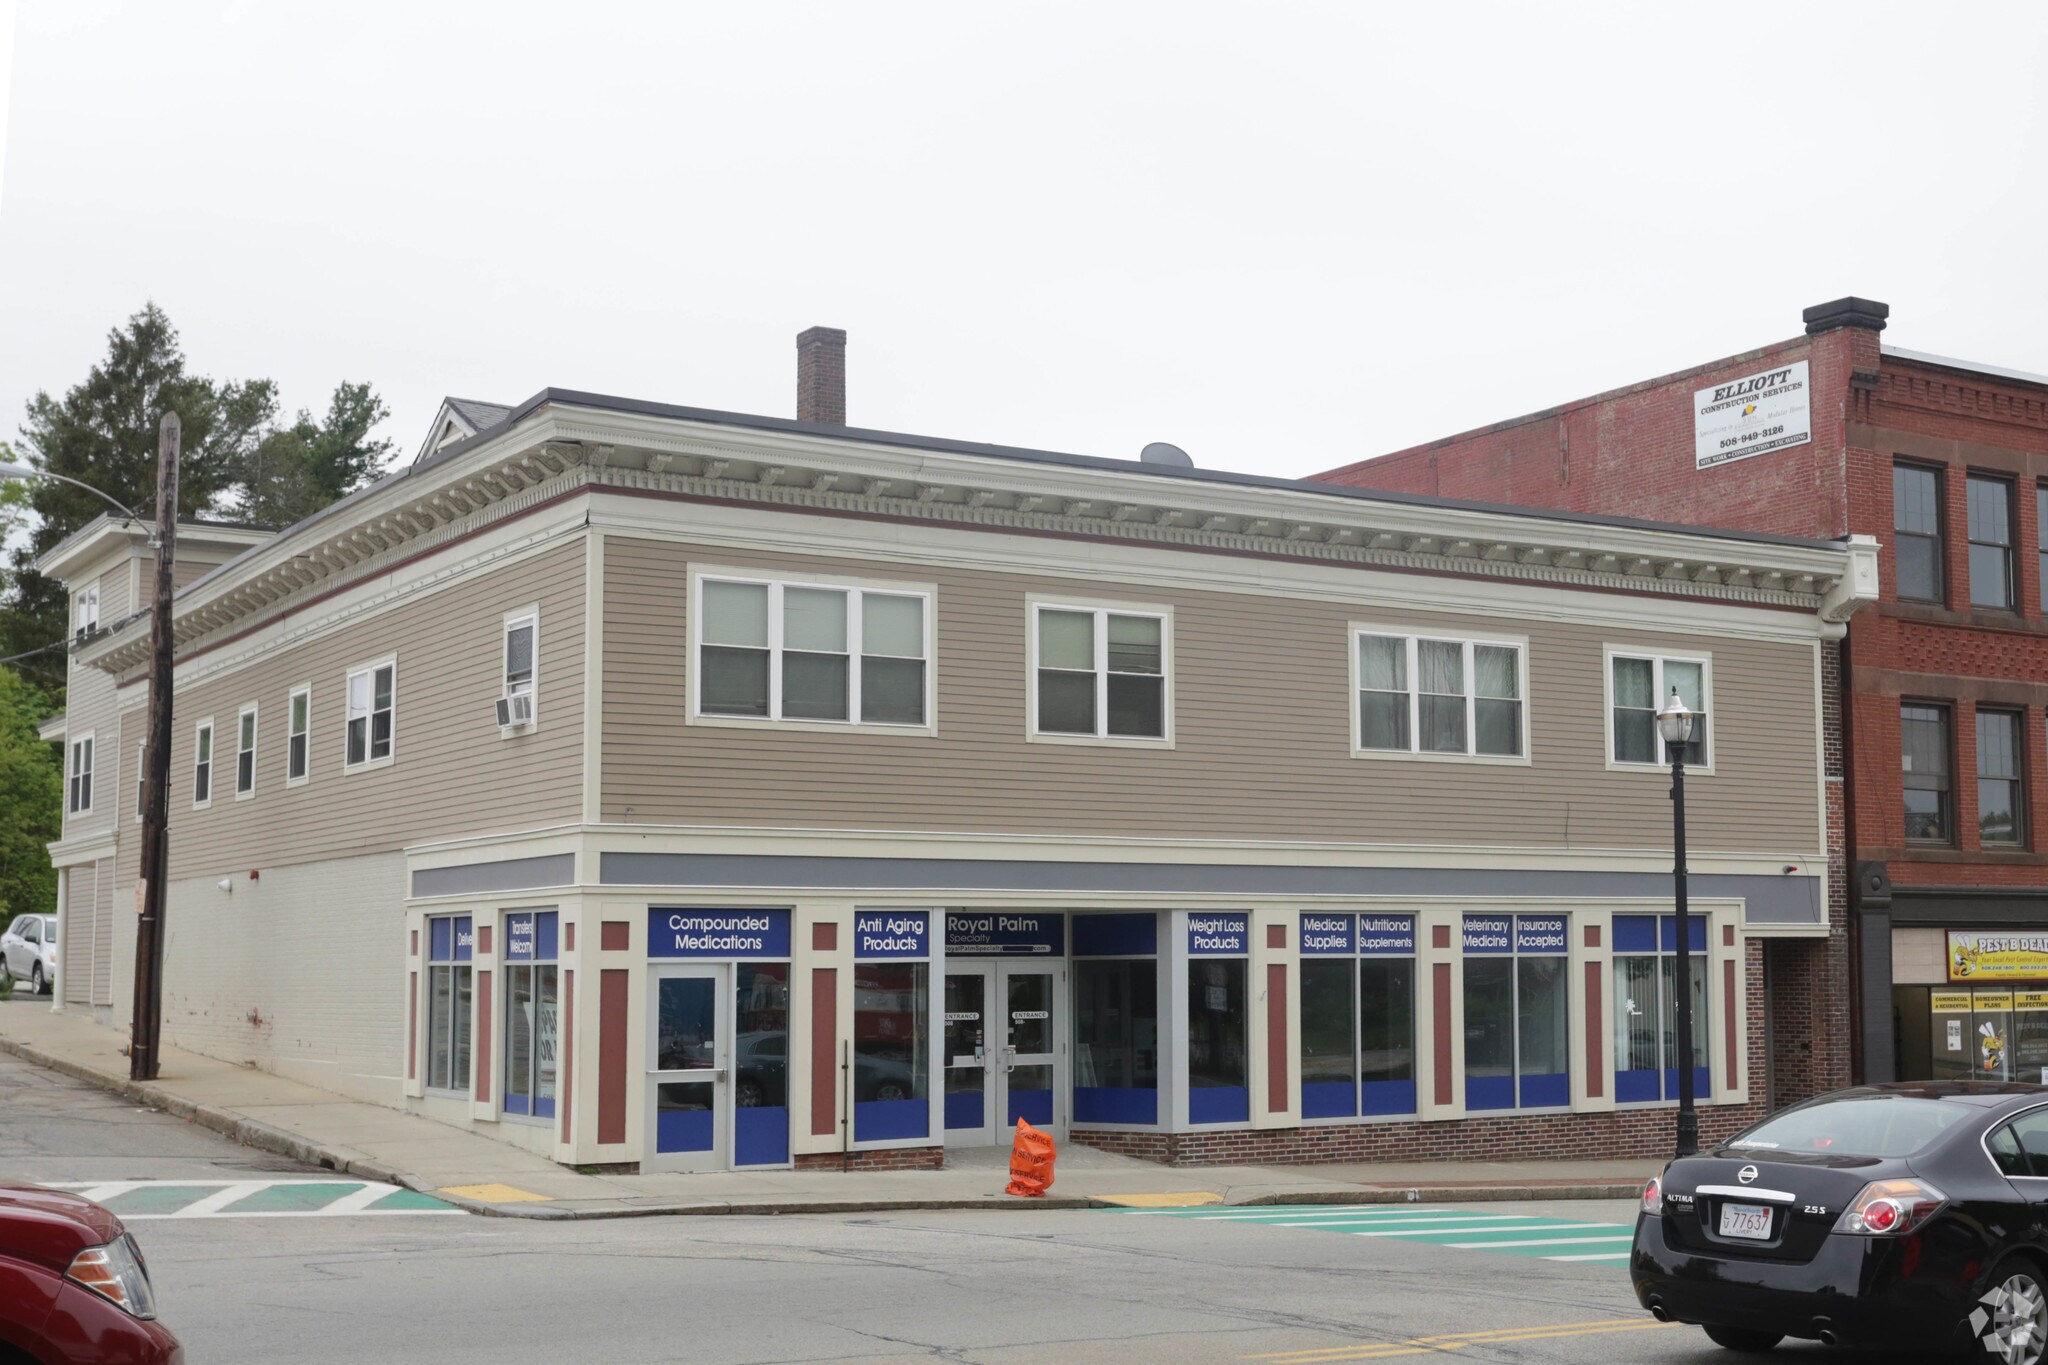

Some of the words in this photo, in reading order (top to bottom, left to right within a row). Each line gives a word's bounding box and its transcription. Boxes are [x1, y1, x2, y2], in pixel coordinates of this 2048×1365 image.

[1712, 369, 1792, 402] ELLIOTT
[1701, 393, 1760, 415] CONSTRUCTION
[1763, 381, 1803, 399] SERVICES
[1719, 425, 1784, 448] 508-949-3126
[1700, 456, 1712, 466] SITE
[1731, 442, 1771, 458] CONSTRUCTION
[668, 915, 769, 933] Compounded
[858, 918, 882, 932] Anti
[886, 919, 924, 935] Aging
[948, 917, 993, 934] Royal
[999, 917, 1038, 931] Palm
[1188, 919, 1223, 935] Weight
[1224, 919, 1244, 932] Loss
[1304, 918, 1347, 931] Medical
[1361, 919, 1411, 931] Nutritional
[1462, 919, 1508, 934] Veterinary
[1517, 919, 1562, 931] Insurance
[675, 934, 762, 950] Medications
[863, 936, 917, 950] Products
[949, 933, 990, 943] Specialty
[1194, 936, 1240, 949] Products
[1304, 935, 1347, 950] Supplies
[1360, 937, 1413, 950] Supplements
[1463, 935, 1508, 947] Medicine
[1518, 934, 1564, 948] Accepted
[1977, 938, 2007, 954] PEST
[2008, 938, 2019, 951] B
[1667, 1194, 1693, 1203] ALTIMA
[1732, 1212, 1769, 1231] 77637
